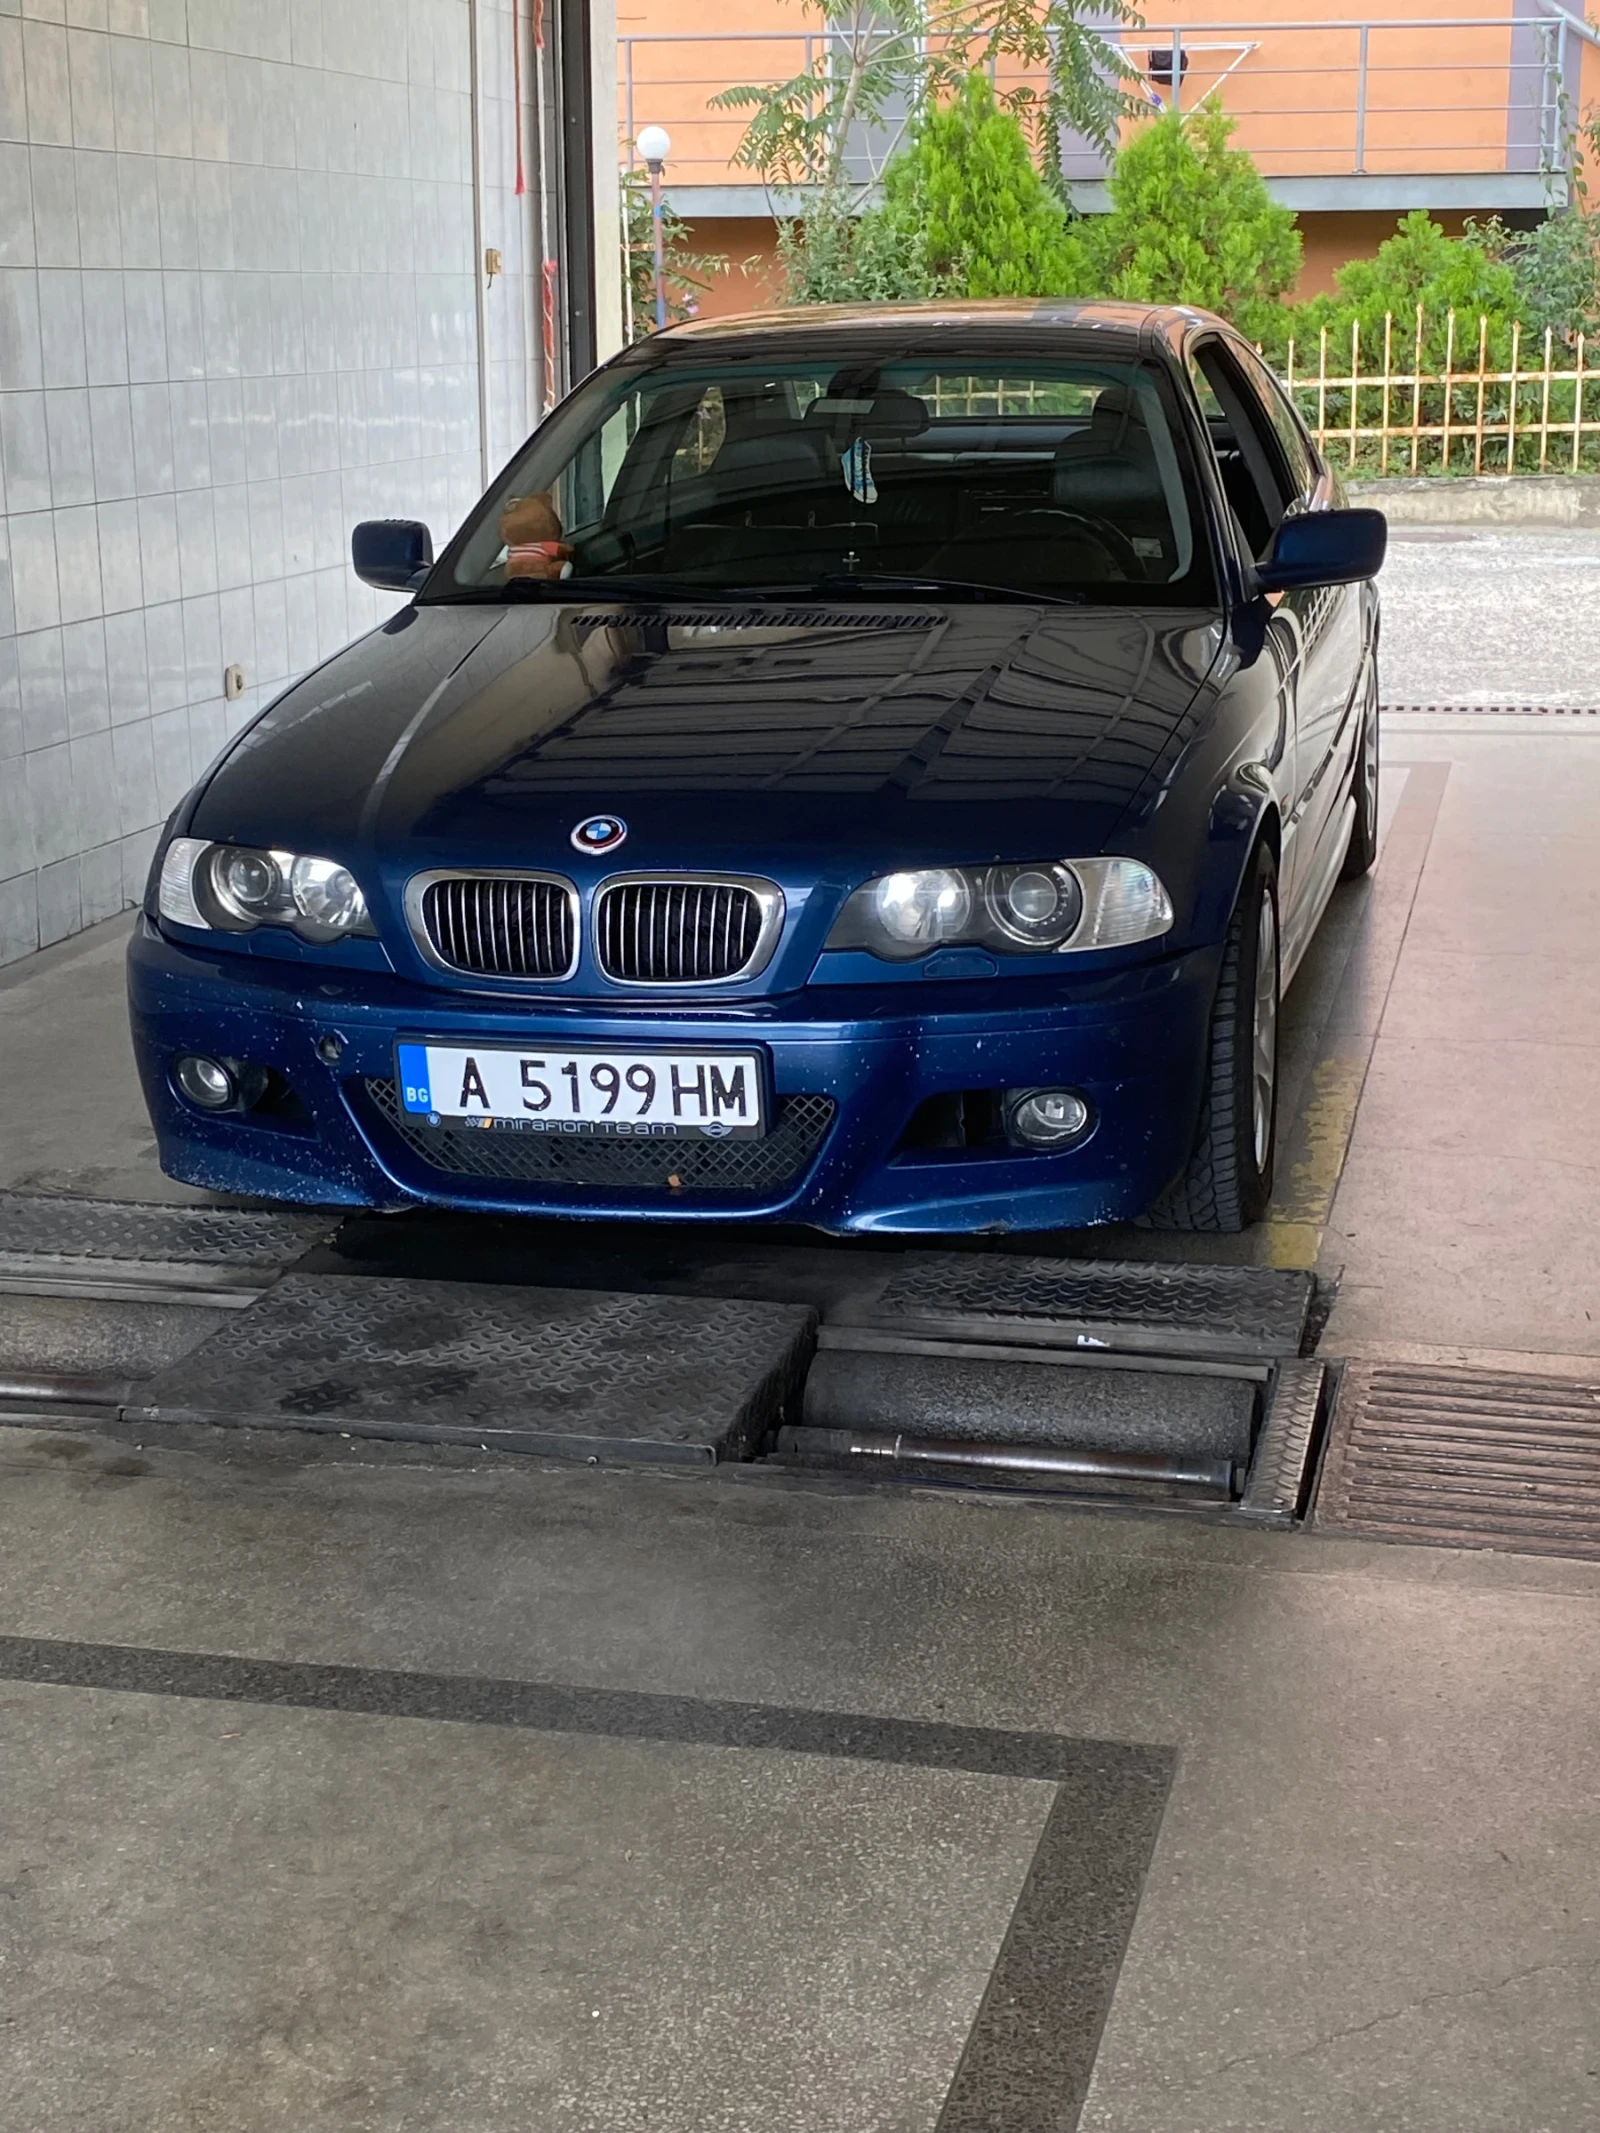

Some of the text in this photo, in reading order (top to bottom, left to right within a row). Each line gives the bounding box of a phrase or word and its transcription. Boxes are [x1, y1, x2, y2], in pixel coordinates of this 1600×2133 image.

[406, 1086, 428, 1103] BG
[459, 1056, 747, 1117] A 5199 HM
